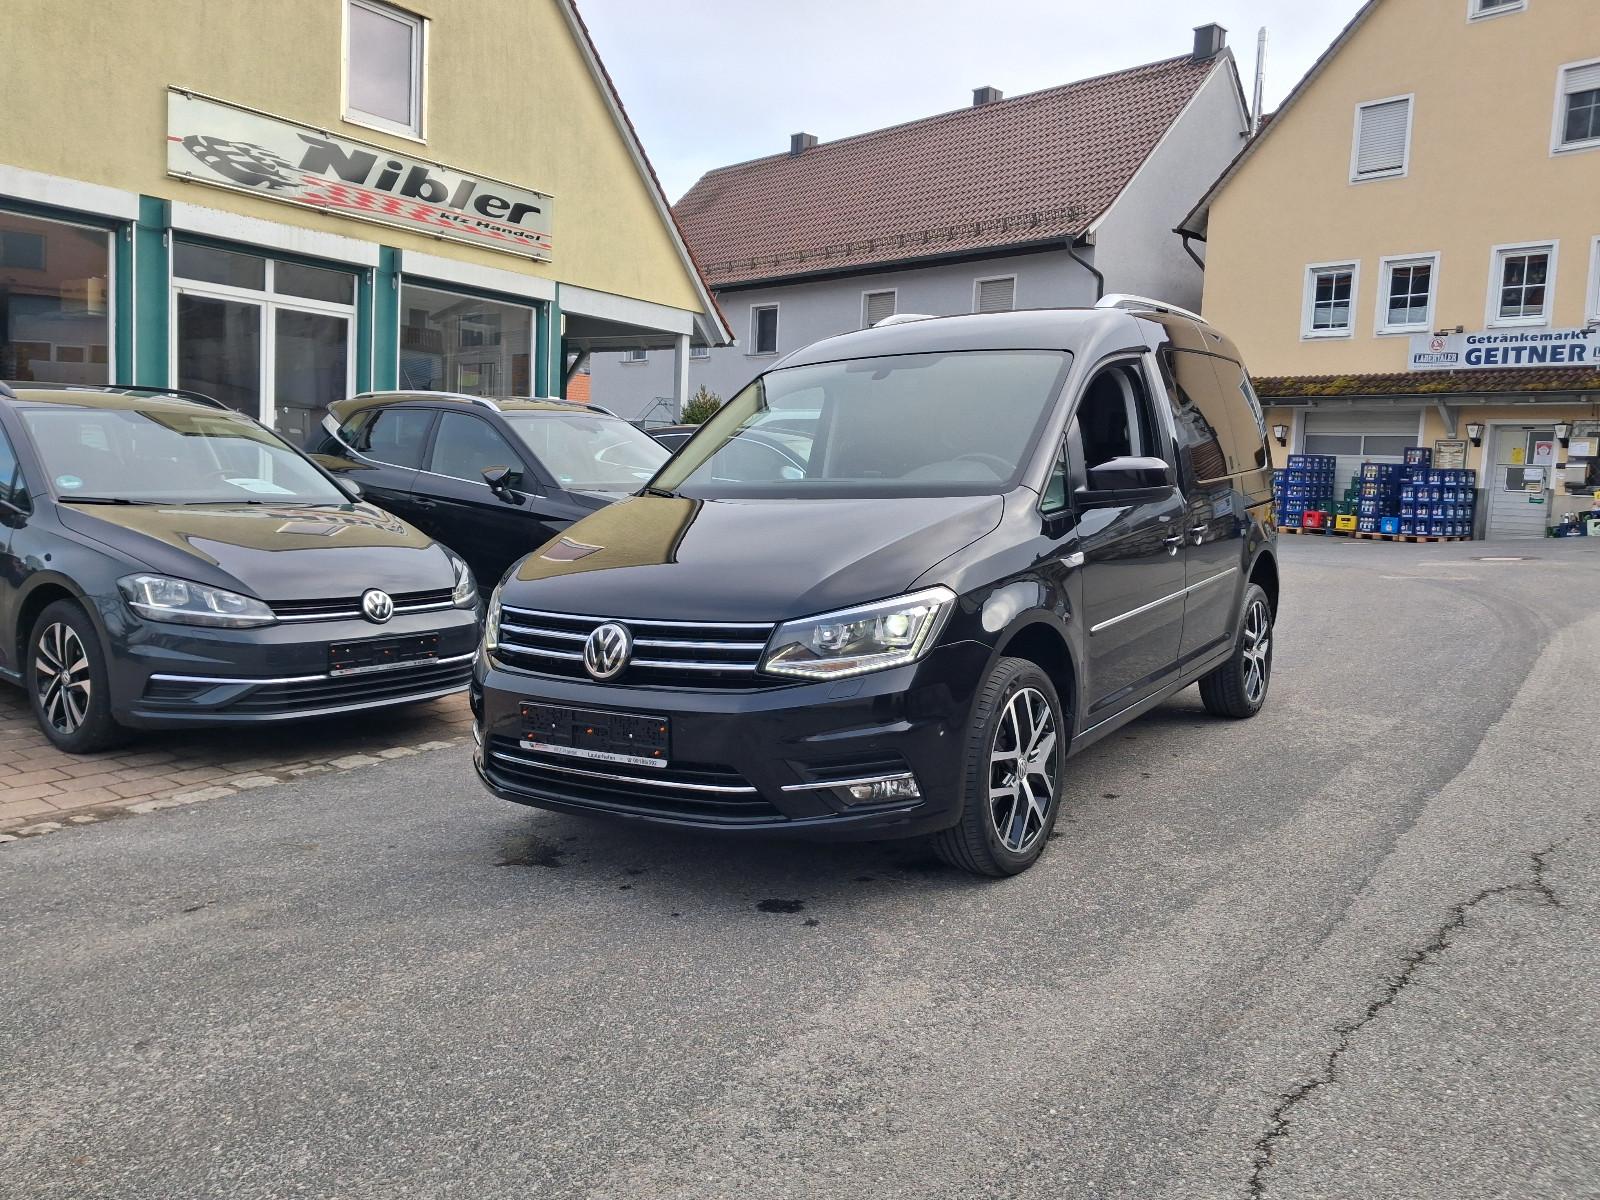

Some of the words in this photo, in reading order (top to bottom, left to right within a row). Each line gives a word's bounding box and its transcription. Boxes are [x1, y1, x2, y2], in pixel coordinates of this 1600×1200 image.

[296, 133, 541, 225] Nibler
[476, 220, 541, 241] Handel
[1466, 330, 1588, 345] Getränkemarkt
[1464, 343, 1587, 366] GEITNER
